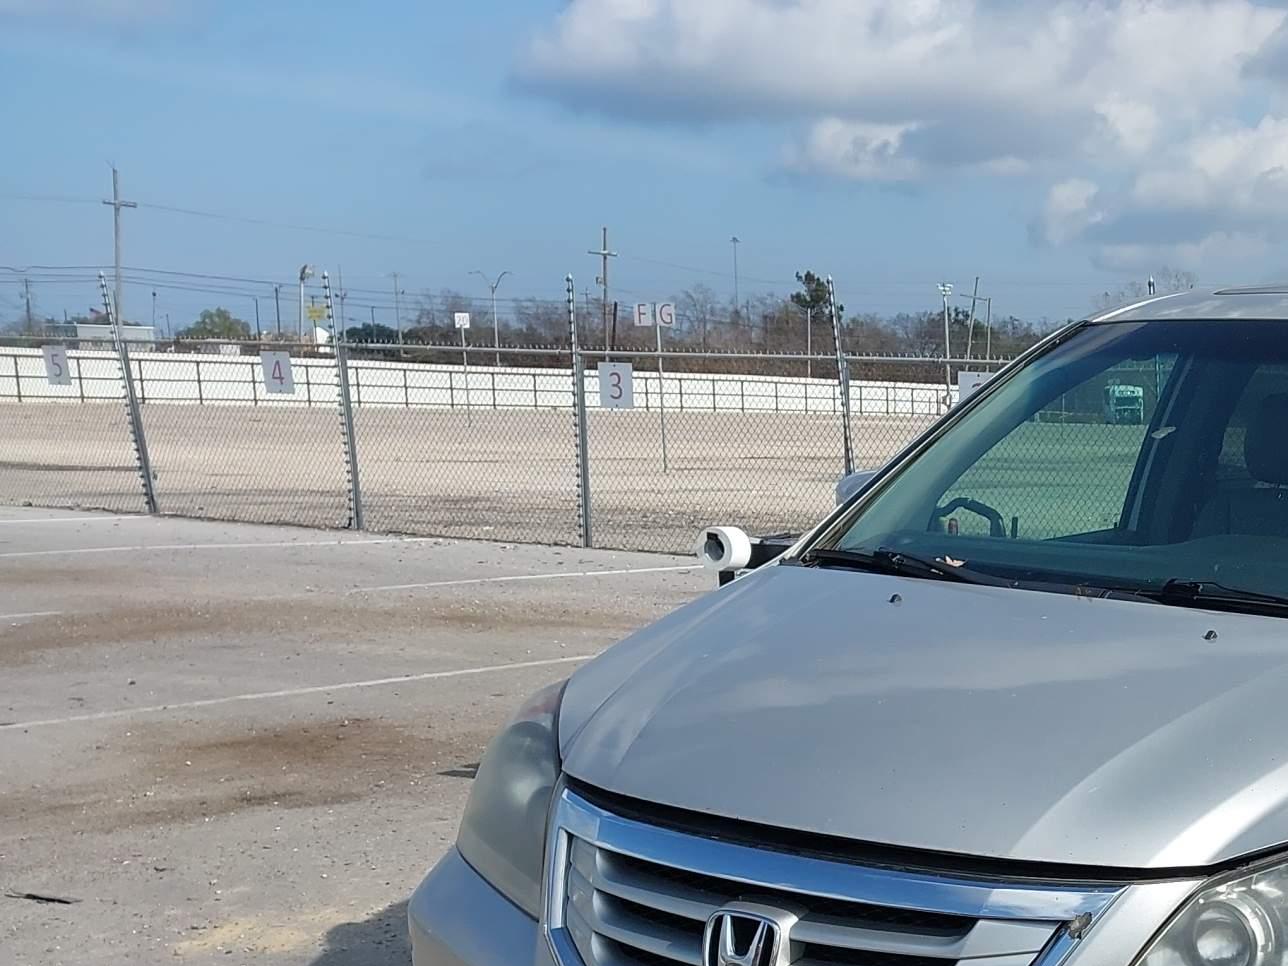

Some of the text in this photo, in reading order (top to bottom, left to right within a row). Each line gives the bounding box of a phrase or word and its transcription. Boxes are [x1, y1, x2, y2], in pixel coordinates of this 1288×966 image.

[637, 303, 646, 324] F
[659, 303, 673, 325] G
[50, 353, 62, 377] 5
[271, 360, 285, 385] 4
[609, 372, 623, 400] 3
